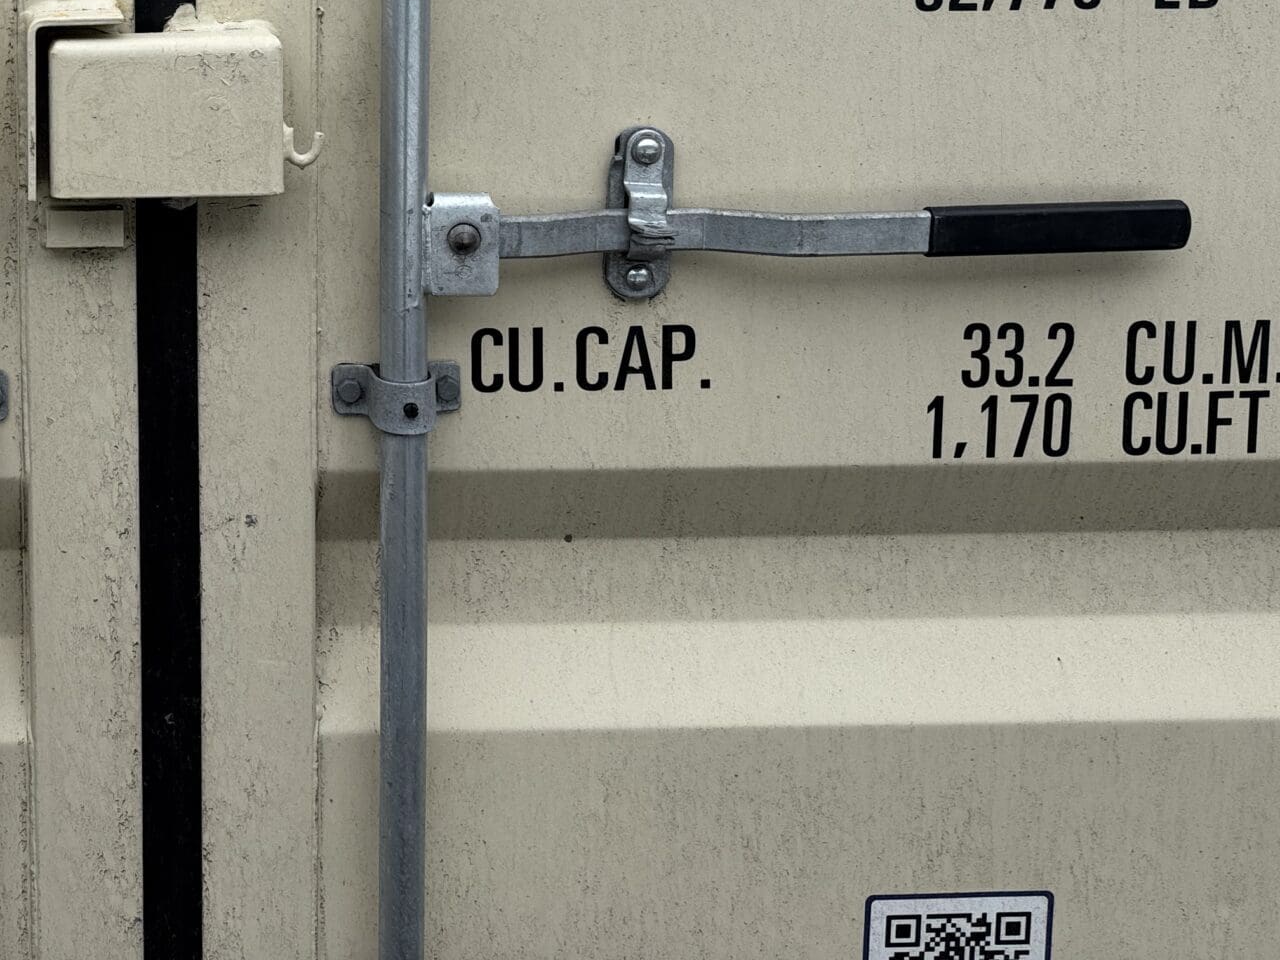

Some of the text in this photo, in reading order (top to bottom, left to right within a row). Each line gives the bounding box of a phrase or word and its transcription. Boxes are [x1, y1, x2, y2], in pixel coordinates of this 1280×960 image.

[961, 322, 1075, 389] 33.2
[926, 390, 1271, 459] 1,170 CU.FT
